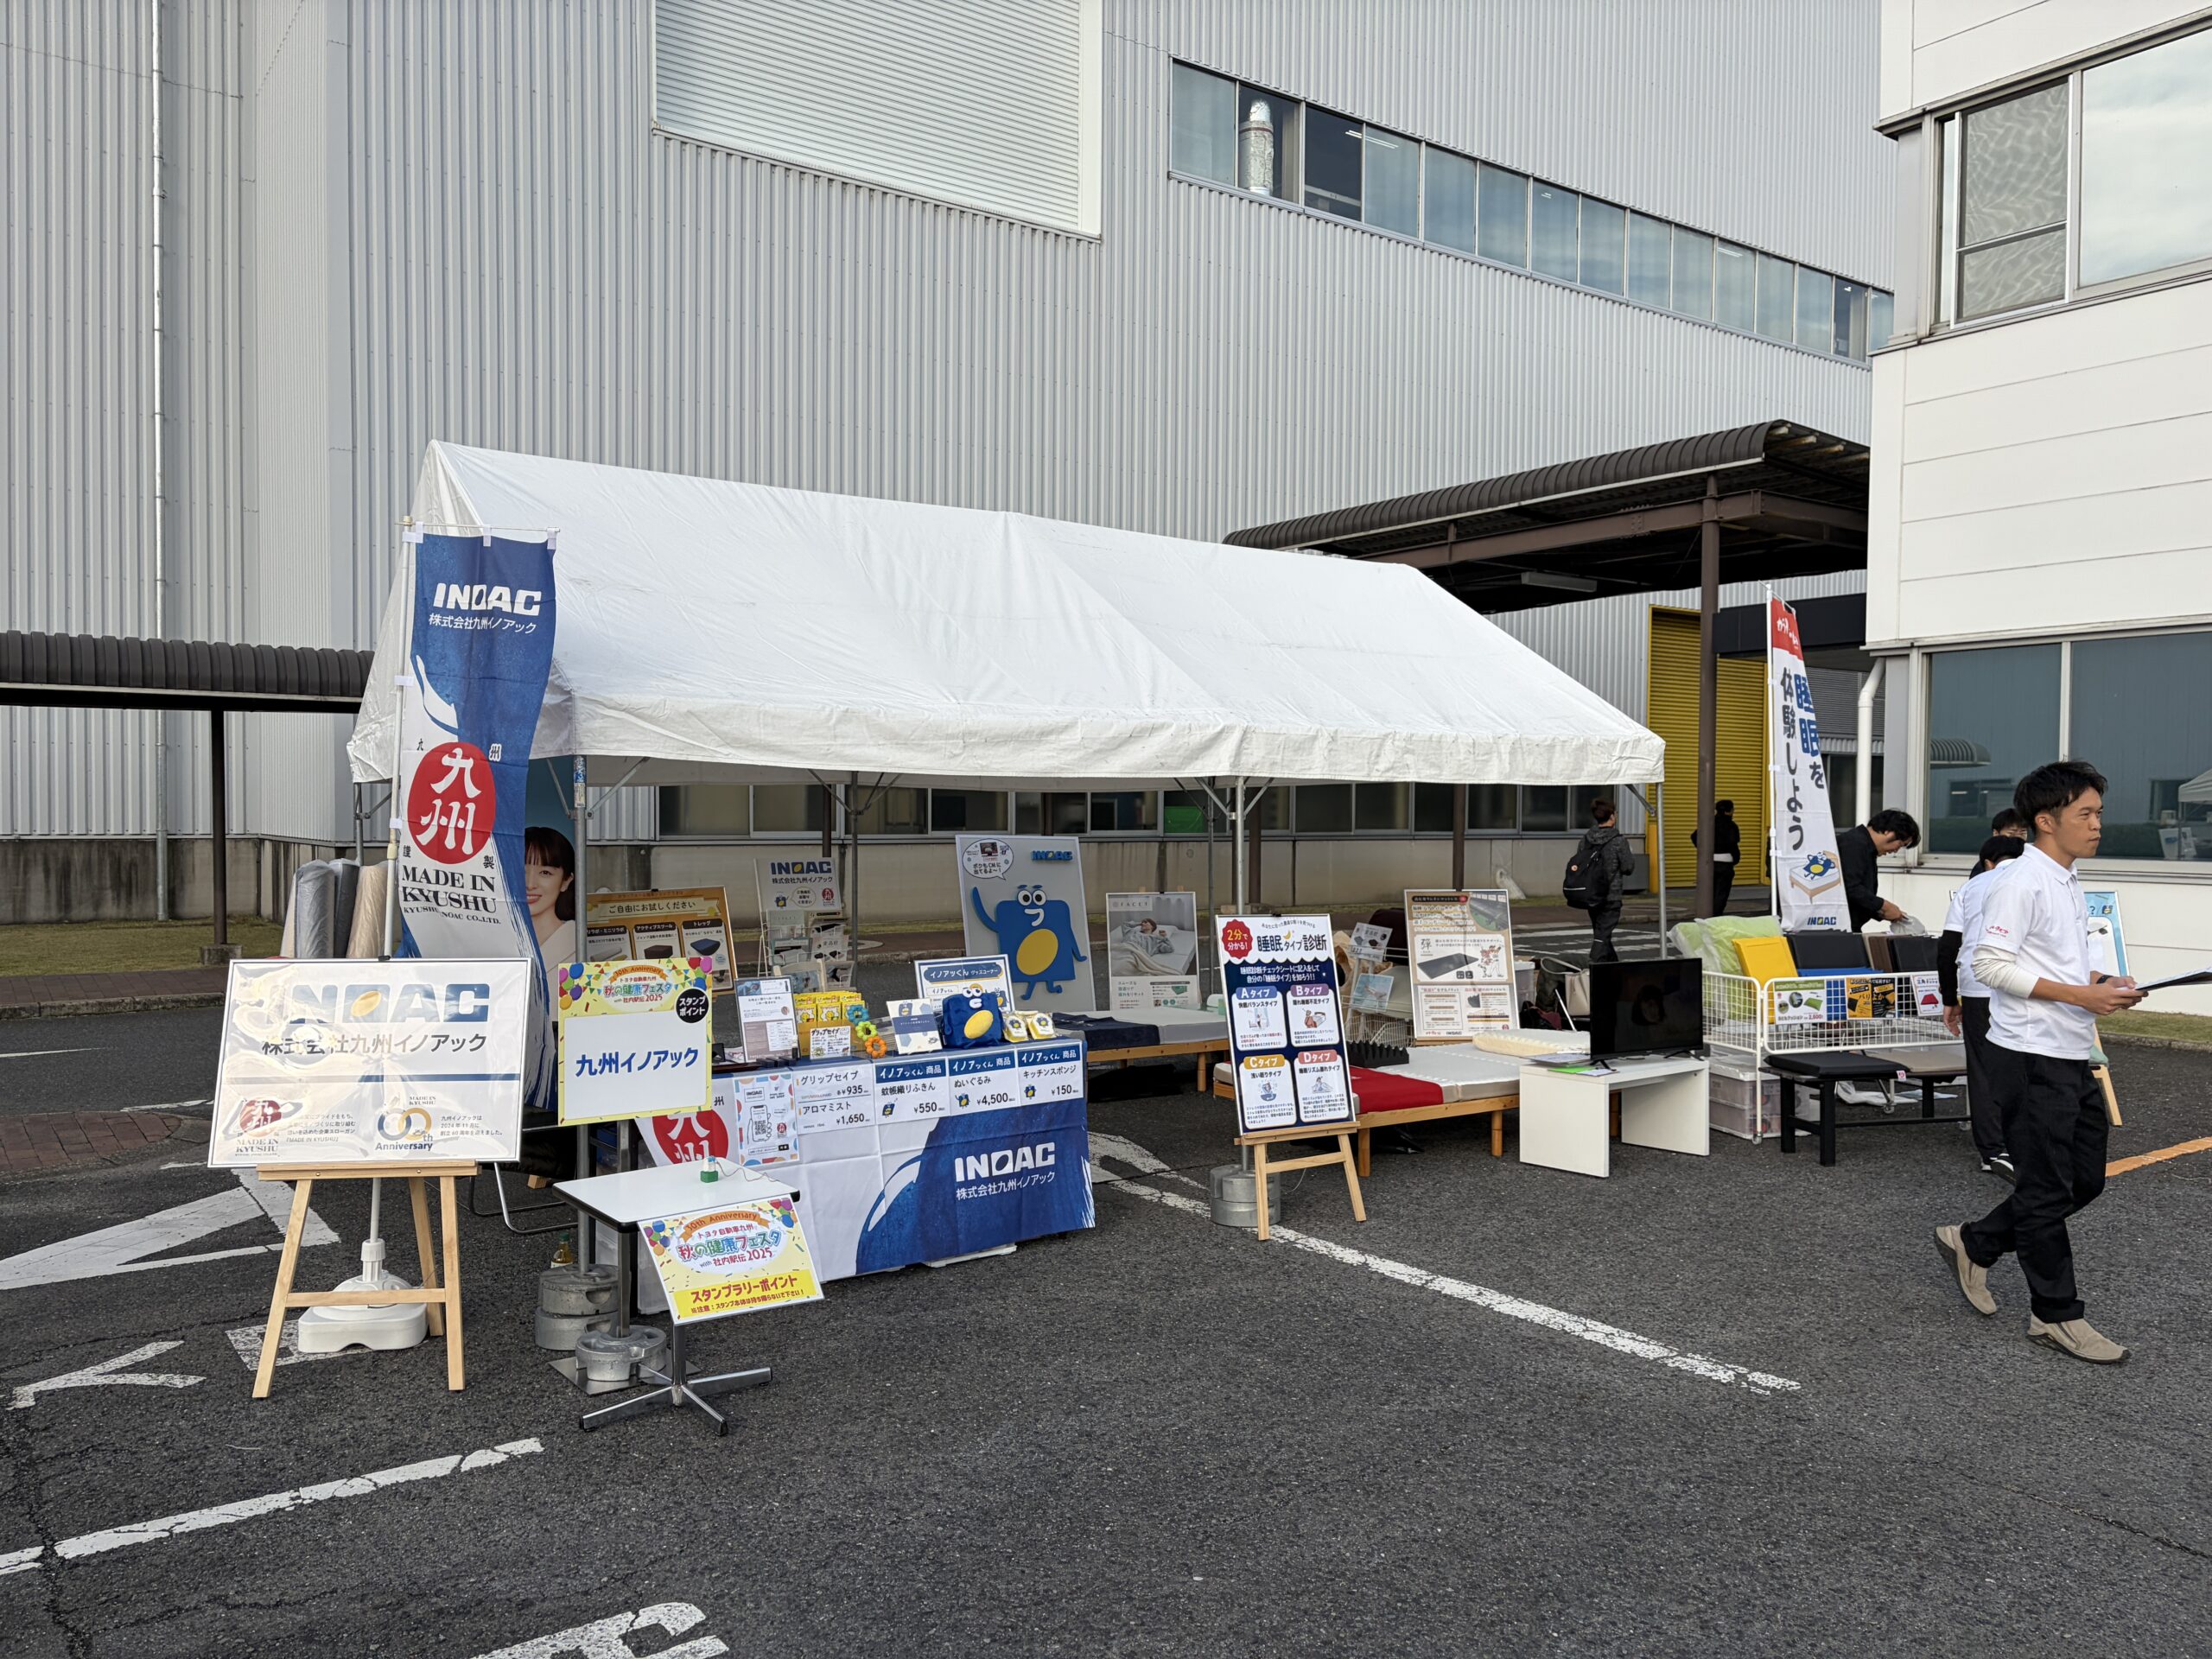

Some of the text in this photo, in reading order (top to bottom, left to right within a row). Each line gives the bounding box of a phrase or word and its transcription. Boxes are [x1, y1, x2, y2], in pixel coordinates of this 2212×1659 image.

[433, 583, 542, 616] INOAC
[429, 613, 537, 634] 株式会社九州イノアック
[489, 744, 502, 761] 州
[1780, 666, 1804, 851] 体験しよう
[416, 747, 481, 855] 九州
[483, 855, 495, 868] 製
[1032, 850, 1073, 861] INOAC
[771, 861, 832, 874] INOAC
[402, 866, 496, 893] MADE IN
[772, 876, 833, 885] 株式会社九州イノアック
[402, 886, 498, 914] KYUSHU
[608, 900, 696, 914] ご自由にお試しください
[1807, 916, 1837, 926] INOAC
[1227, 929, 1248, 941] 2分で
[1257, 934, 1327, 952] 睡眠タイプ診断
[604, 982, 673, 998] 秋の健康フェスタ
[1241, 988, 1270, 999] Aタイプ
[1296, 985, 1323, 996] Bタイプ
[645, 994, 663, 1002] 2025
[679, 995, 706, 1006] スタンプ
[679, 1007, 706, 1016] ポイント
[1062, 1049, 1077, 1058] 商品
[1304, 1052, 1332, 1063] Dタイプ
[575, 1047, 698, 1077] 九州イノアック
[996, 1057, 1011, 1066] 商品
[1250, 1057, 1278, 1067] Cタイプ
[925, 1065, 942, 1074] 商品
[1023, 1065, 1077, 1078] キッチンスポンジ
[801, 1071, 858, 1085] グリップセイブ
[954, 1076, 991, 1089] ぬいぐるみ
[880, 1082, 936, 1096] 蚊帳織りふきん
[1051, 1084, 1072, 1096] ¥150
[976, 1092, 1008, 1106] ¥4,500
[803, 1101, 851, 1115] アロマミスト
[913, 1102, 938, 1113] ¥550
[375, 1141, 433, 1151] Anniversary
[955, 1141, 1056, 1183] INOAC
[956, 1171, 1056, 1201] 株式会社九州イノアック
[709, 1211, 758, 1224] Anniversary
[697, 1224, 754, 1240] トヨタ自動車九州
[677, 1229, 782, 1262] 秋の健康フェスタ
[713, 1253, 747, 1267] 社内駅伝
[747, 1247, 773, 1262] 2025
[690, 1274, 798, 1304] スタンプラリーポイント
